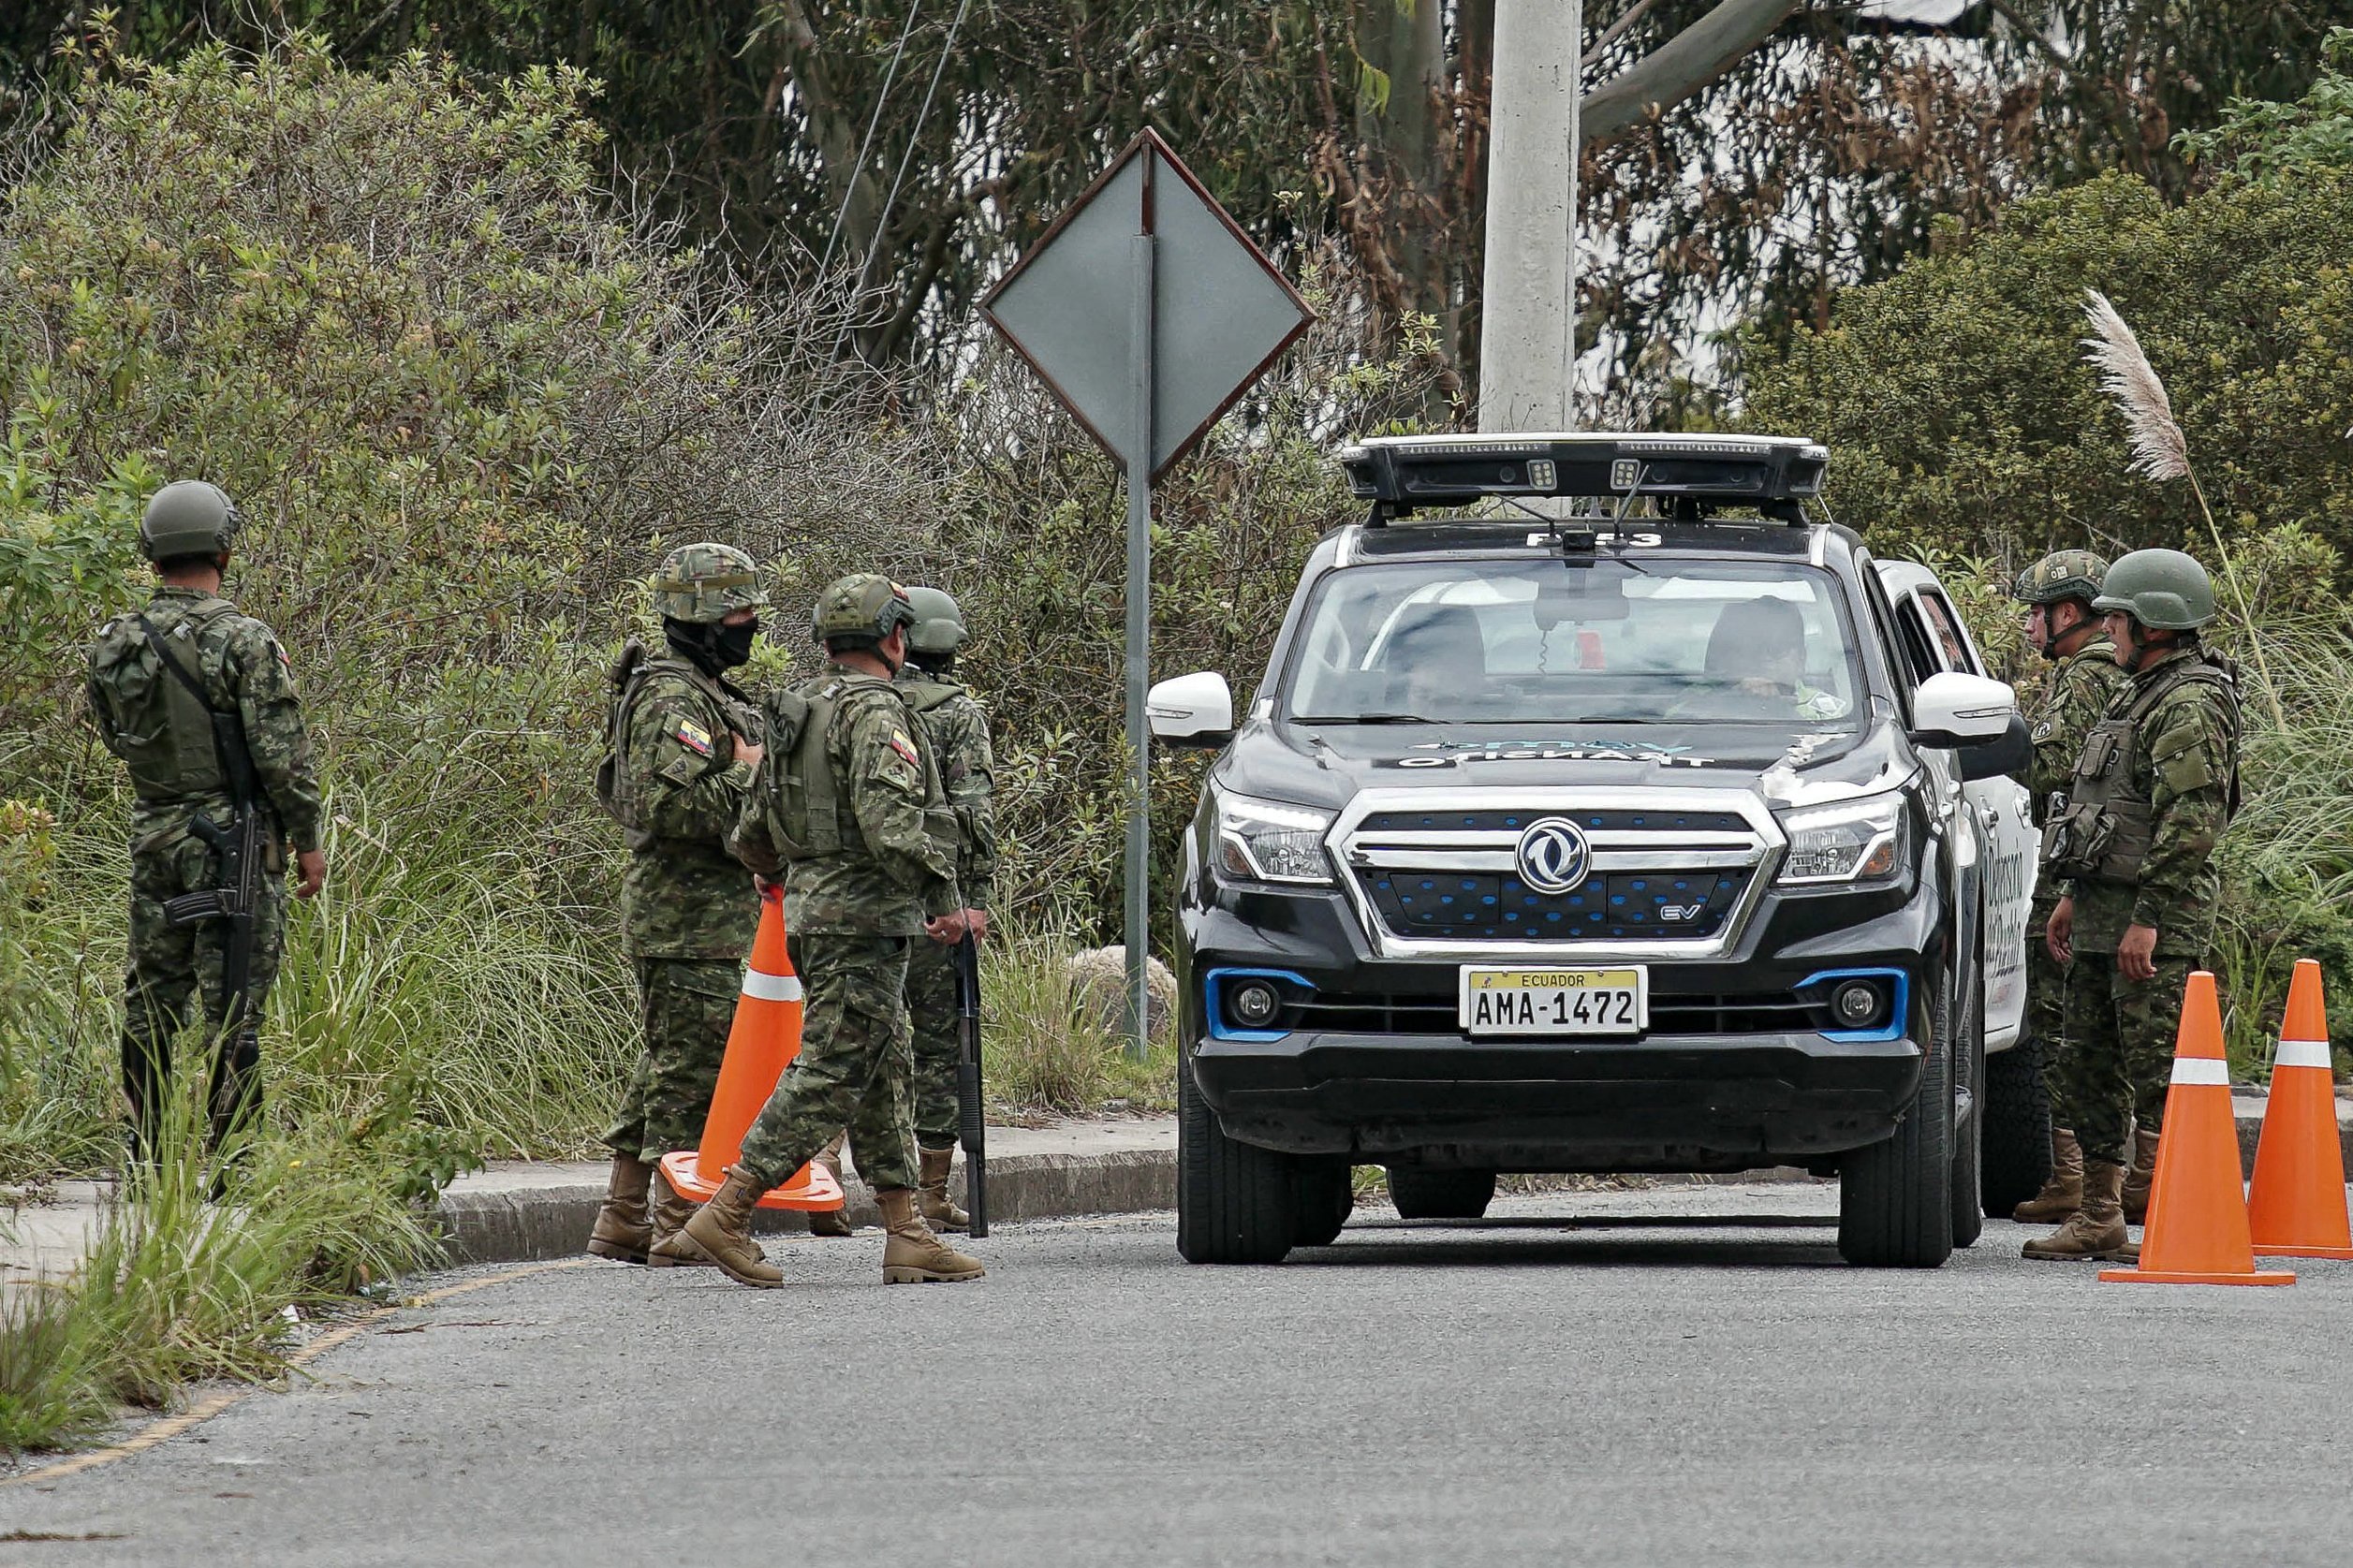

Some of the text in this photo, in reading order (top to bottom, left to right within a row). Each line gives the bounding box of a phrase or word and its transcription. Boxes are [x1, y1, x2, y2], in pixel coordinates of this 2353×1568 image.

[1660, 904, 1701, 920] EV
[1522, 975, 1584, 988] ECUADOR
[1476, 991, 1633, 1025] AMA-1472
